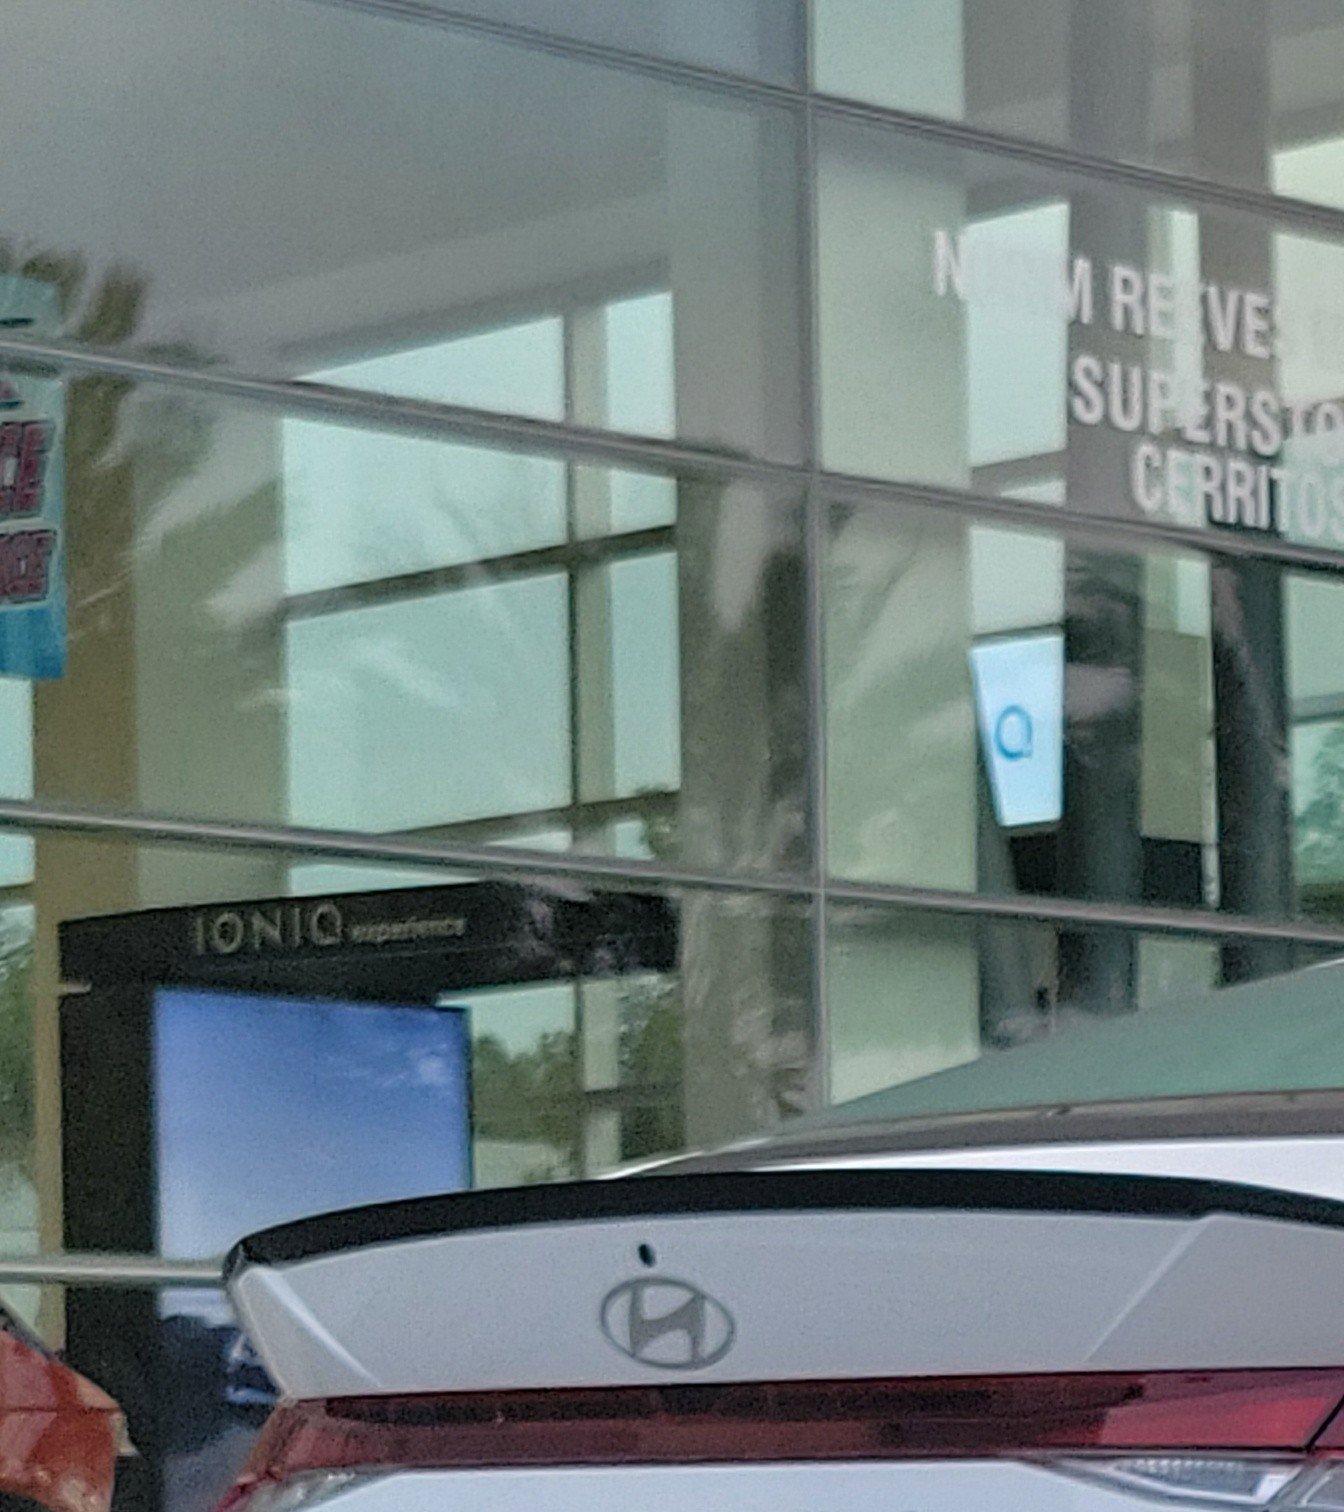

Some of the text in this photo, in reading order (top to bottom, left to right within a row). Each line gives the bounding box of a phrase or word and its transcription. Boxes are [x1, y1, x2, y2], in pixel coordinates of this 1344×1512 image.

[932, 229, 1093, 325] NM
[1111, 264, 1280, 359] REVE
[195, 903, 343, 955] IONIQ
